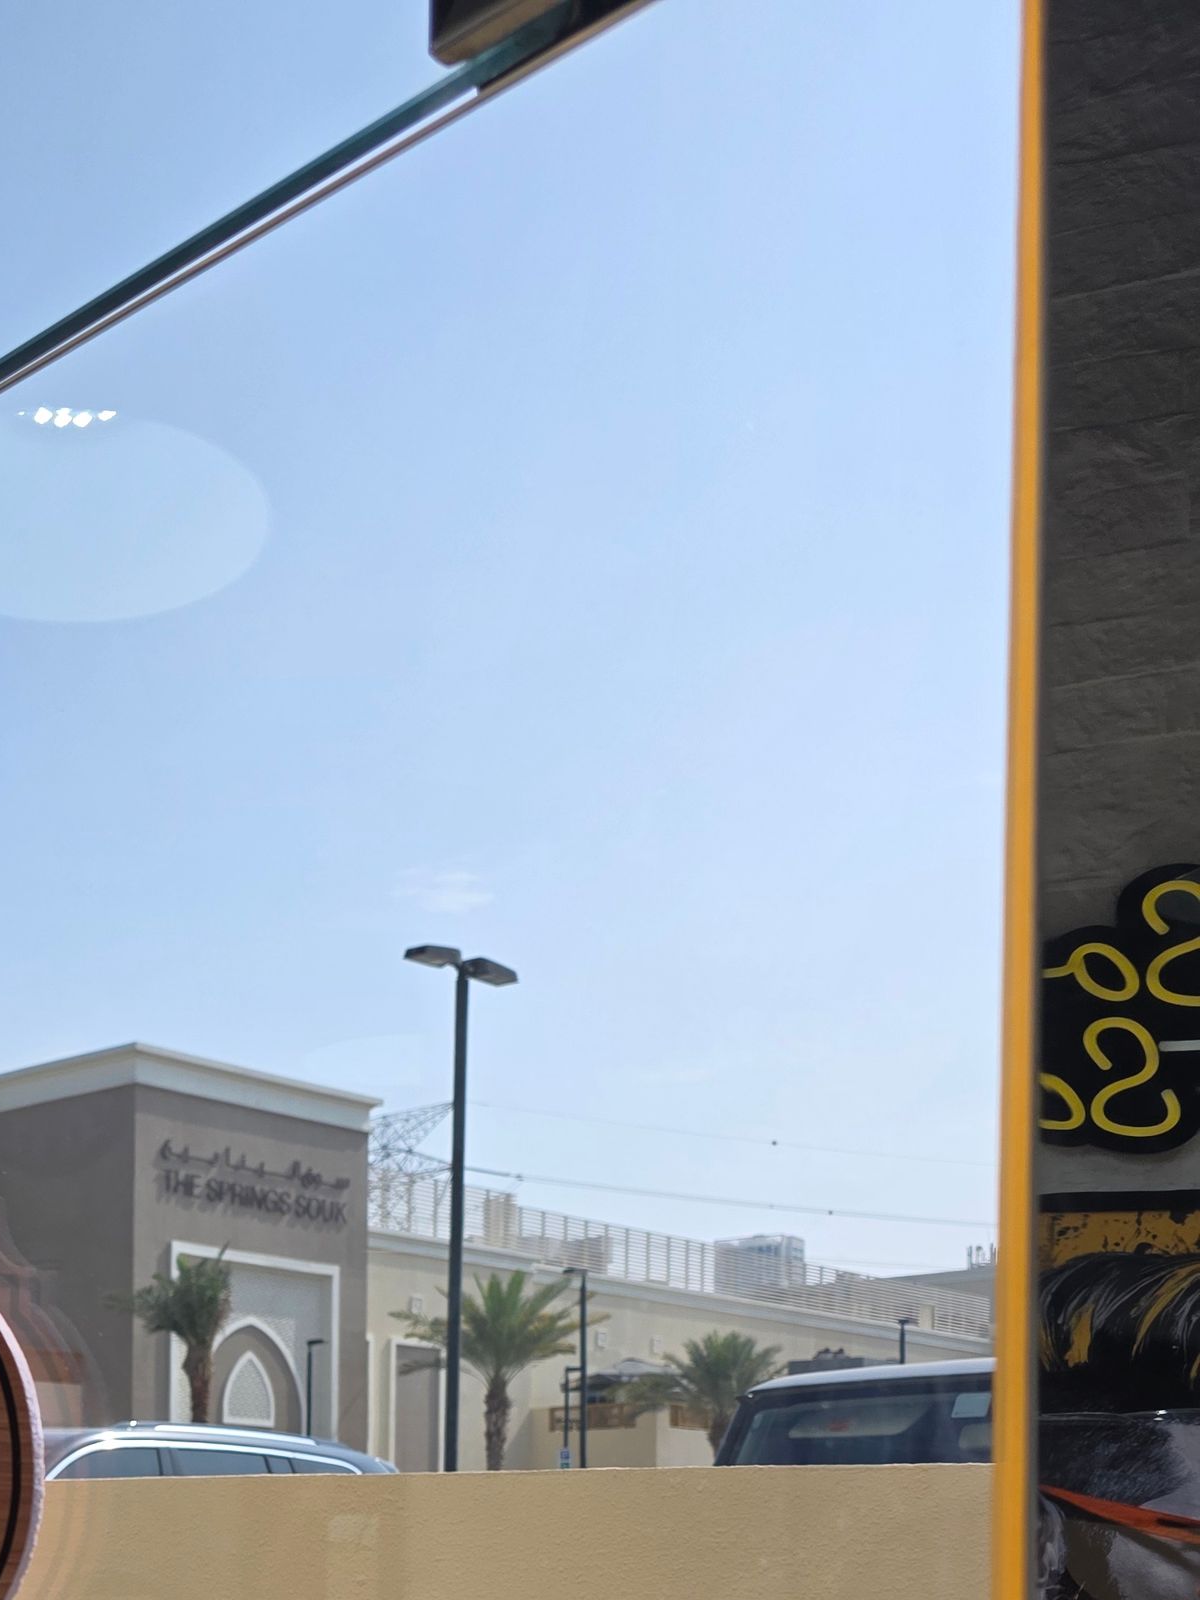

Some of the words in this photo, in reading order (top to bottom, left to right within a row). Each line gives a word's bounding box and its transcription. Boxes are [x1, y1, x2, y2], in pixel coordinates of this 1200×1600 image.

[162, 1169, 202, 1197] THE
[206, 1178, 291, 1214] SPRINGS
[295, 1195, 347, 1224] SOUK
